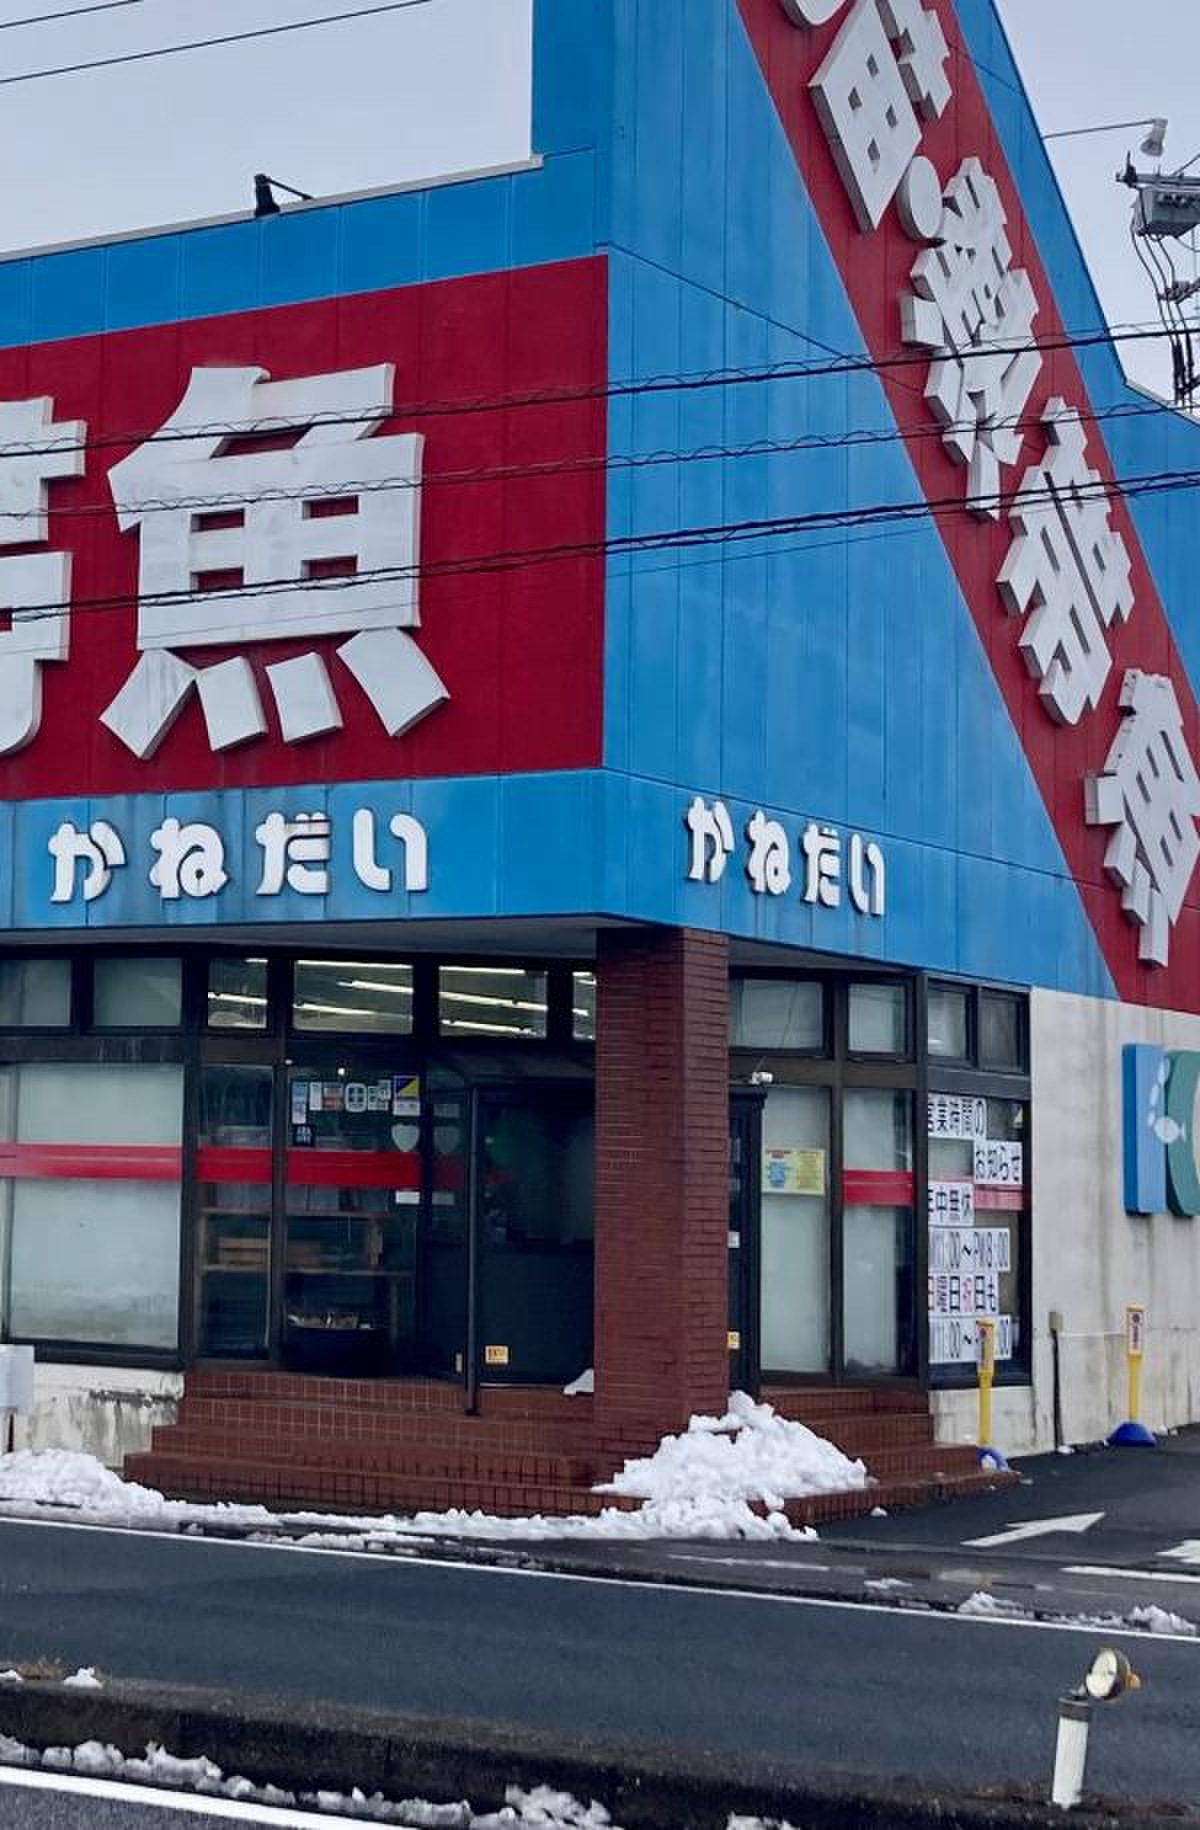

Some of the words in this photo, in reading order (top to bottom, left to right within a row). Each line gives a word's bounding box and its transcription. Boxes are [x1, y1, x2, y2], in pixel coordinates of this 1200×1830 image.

[48, 808, 428, 901] かねだい
[686, 797, 885, 915] かねだい
[975, 1145, 1021, 1182] お知らせ
